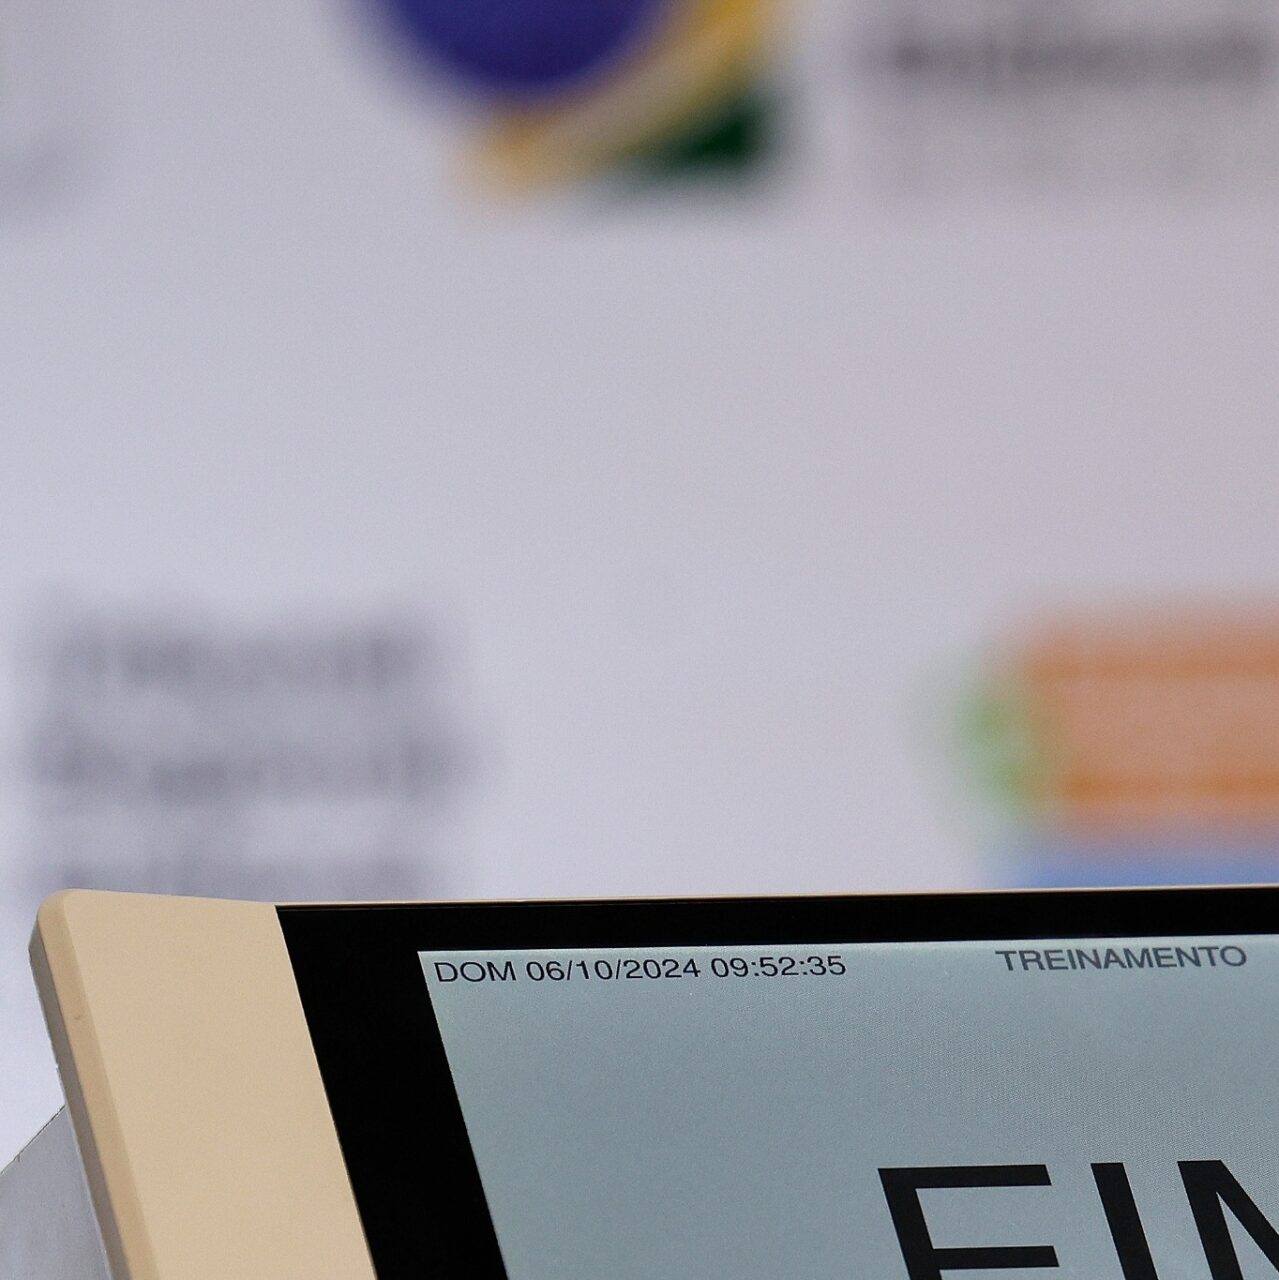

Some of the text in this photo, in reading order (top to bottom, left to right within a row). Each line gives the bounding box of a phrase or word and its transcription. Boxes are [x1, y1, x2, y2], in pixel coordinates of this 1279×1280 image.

[433, 953, 848, 984] DOM 06/10/2024 09:52:35
[995, 945, 1248, 973] TREINAMENTO
